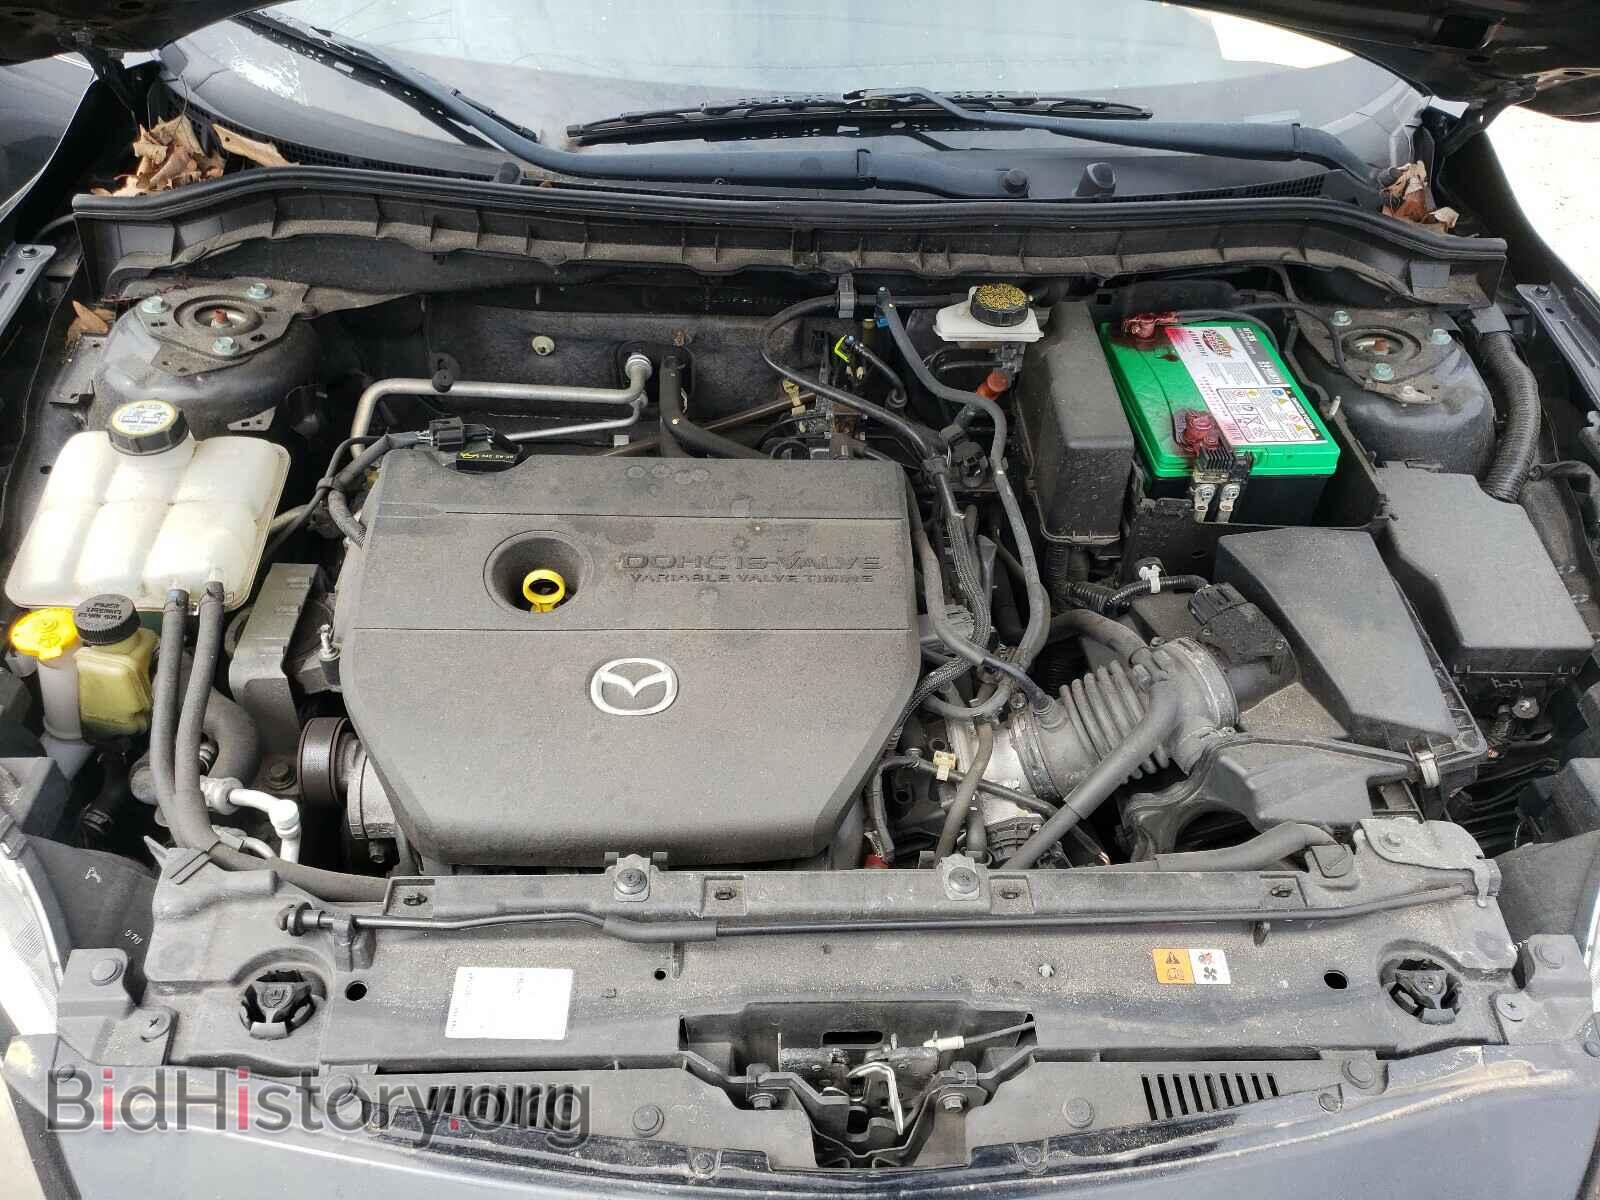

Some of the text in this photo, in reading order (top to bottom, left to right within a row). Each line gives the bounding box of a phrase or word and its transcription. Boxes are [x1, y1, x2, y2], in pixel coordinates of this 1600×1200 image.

[621, 555, 729, 570] DOHC
[630, 573, 731, 584] VARIABLE
[736, 573, 797, 584] VALVE
